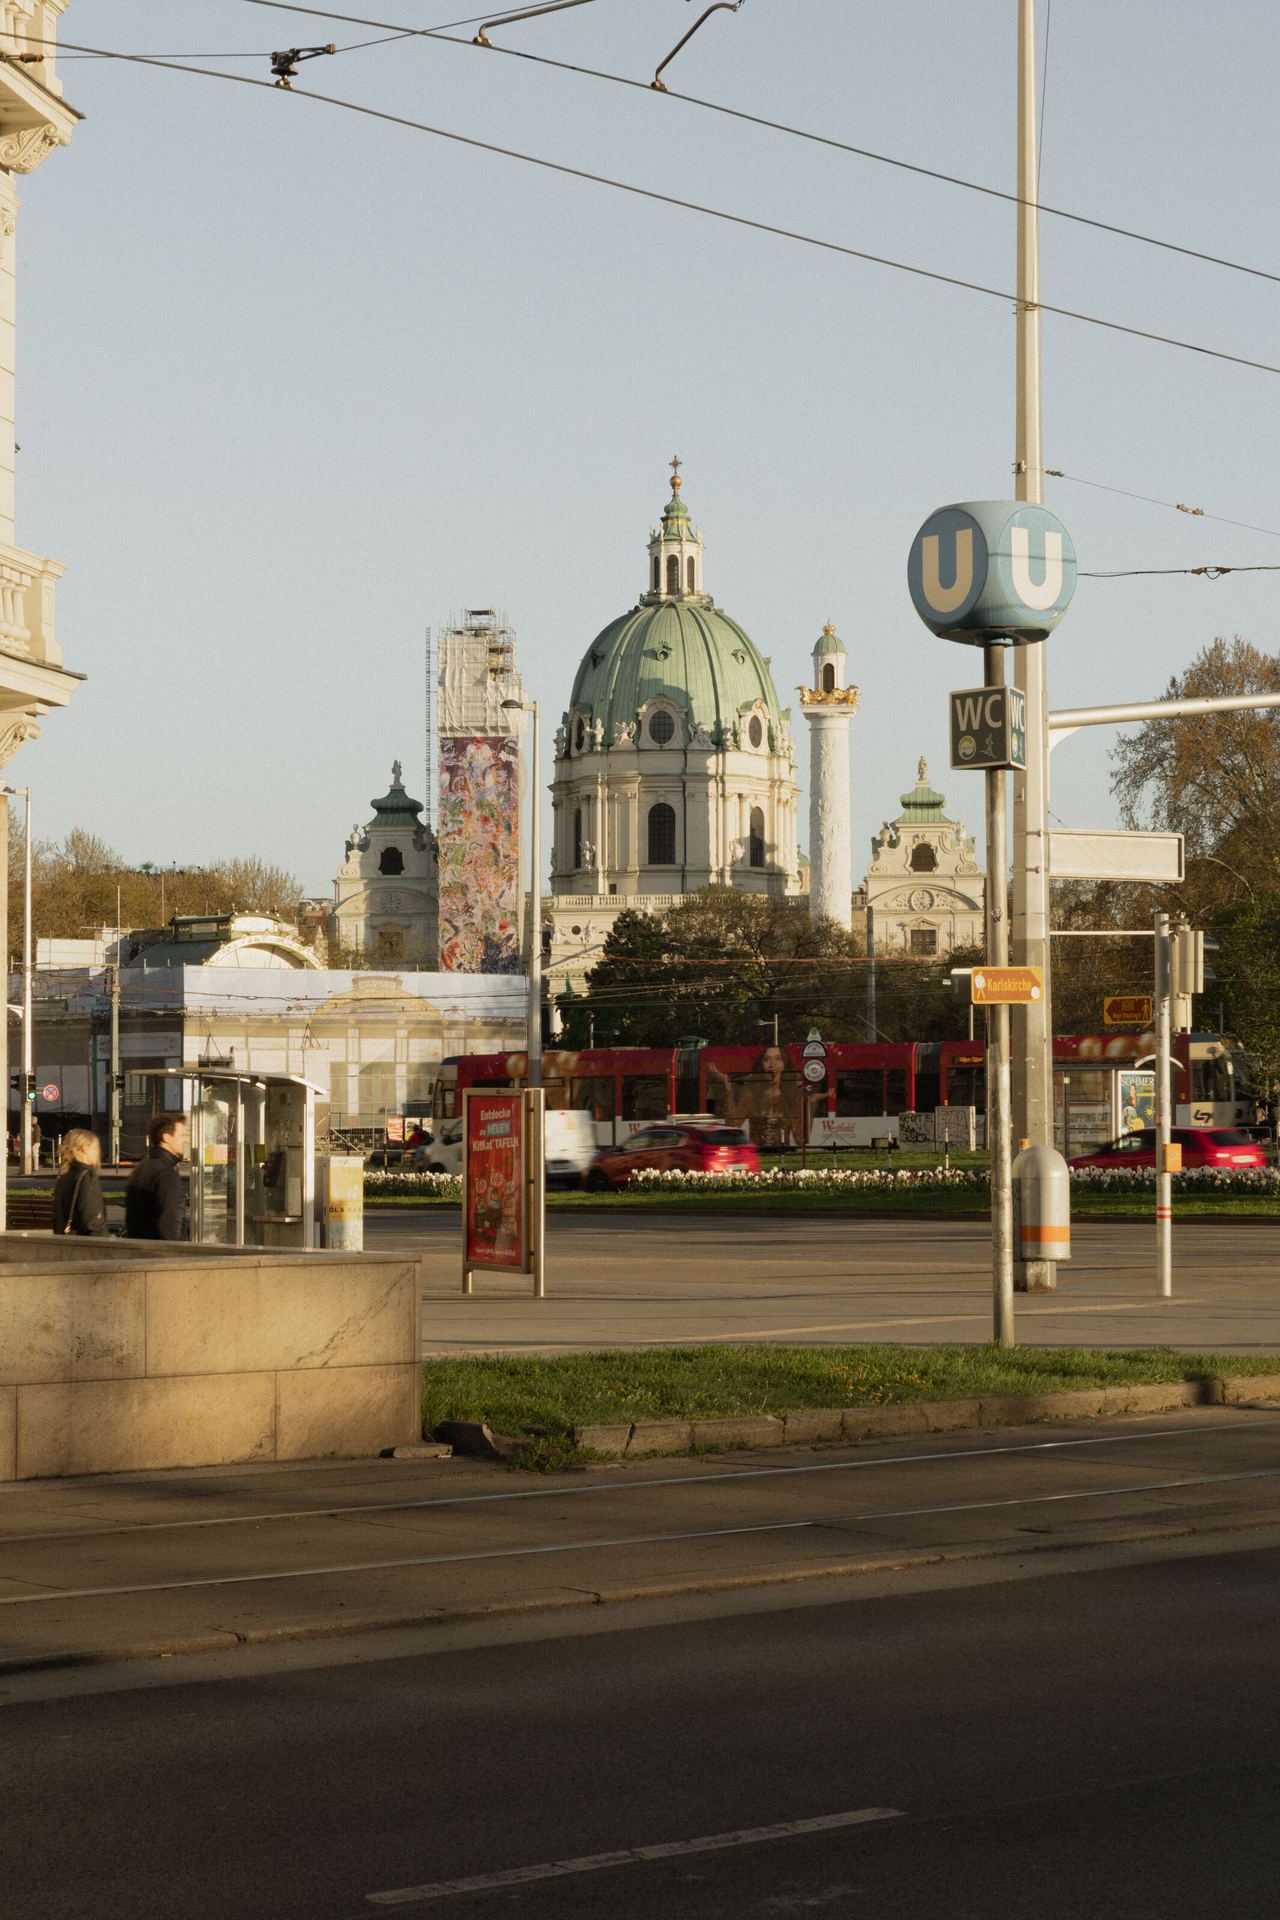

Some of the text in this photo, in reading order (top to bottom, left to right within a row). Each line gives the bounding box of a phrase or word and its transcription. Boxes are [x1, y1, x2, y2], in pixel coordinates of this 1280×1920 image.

[922, 527, 974, 614] U
[1011, 526, 1063, 611] U
[955, 694, 1002, 732] WC
[1010, 694, 1025, 733] WC
[987, 978, 1032, 992] Karlskirche
[1121, 1076, 1155, 1087] SOMMER
[480, 1108, 511, 1121] Entdecke
